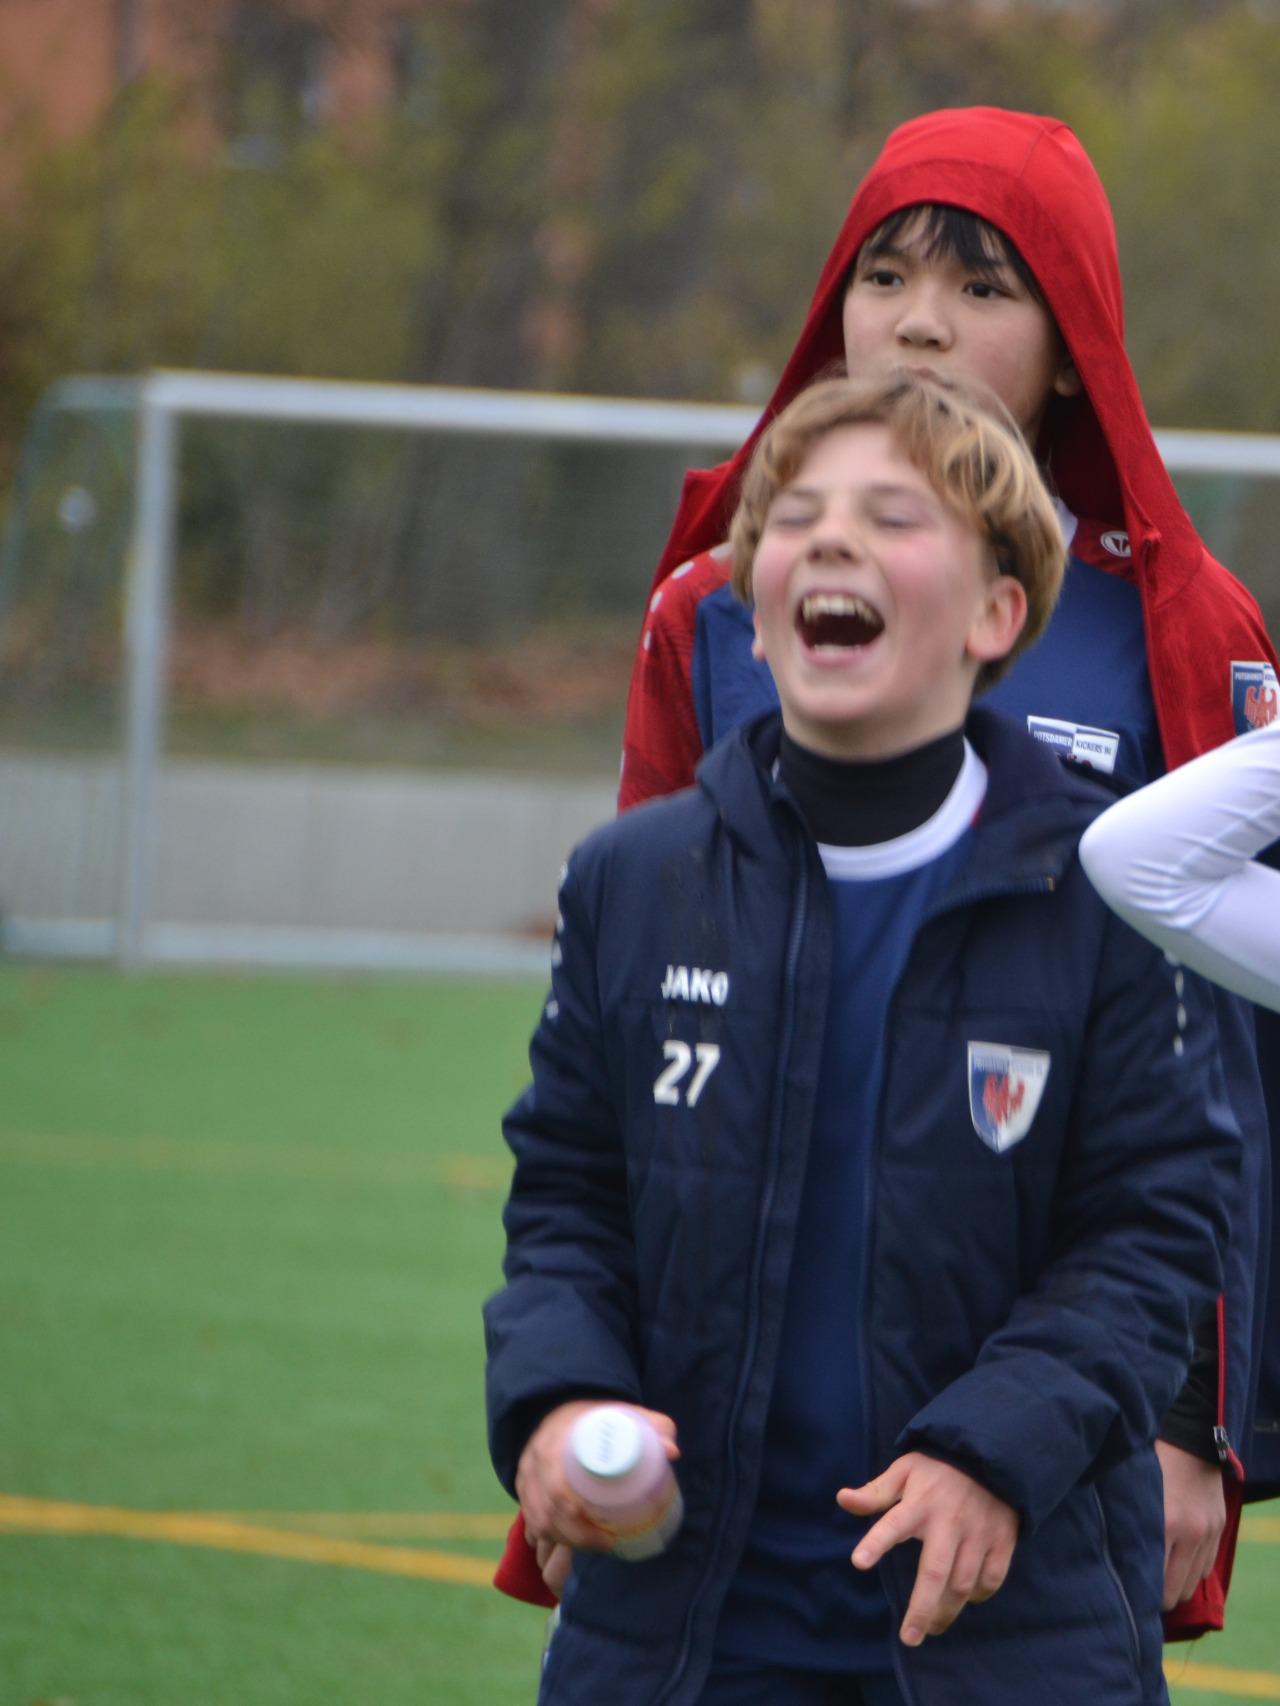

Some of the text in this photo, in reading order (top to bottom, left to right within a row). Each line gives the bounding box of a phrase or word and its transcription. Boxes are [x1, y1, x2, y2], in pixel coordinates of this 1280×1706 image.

[1075, 739, 1103, 754] KICKERS
[661, 964, 729, 1006] JAKO
[653, 1039, 720, 1108] 27
